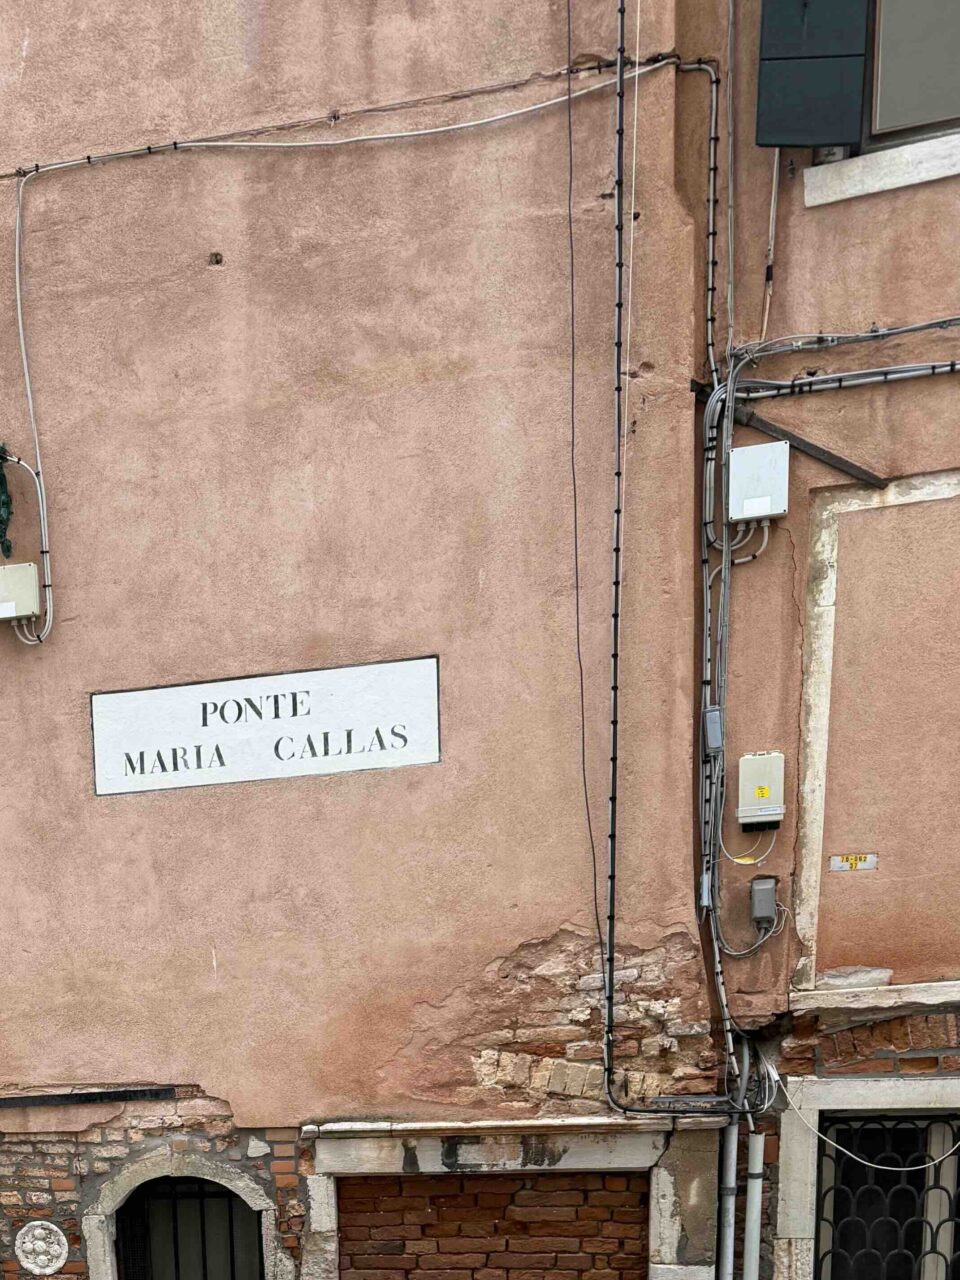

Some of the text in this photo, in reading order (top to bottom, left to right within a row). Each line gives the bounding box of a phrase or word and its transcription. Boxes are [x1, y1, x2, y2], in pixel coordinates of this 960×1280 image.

[201, 690, 311, 727] PONTE
[124, 724, 408, 776] MARIA CALLAS
